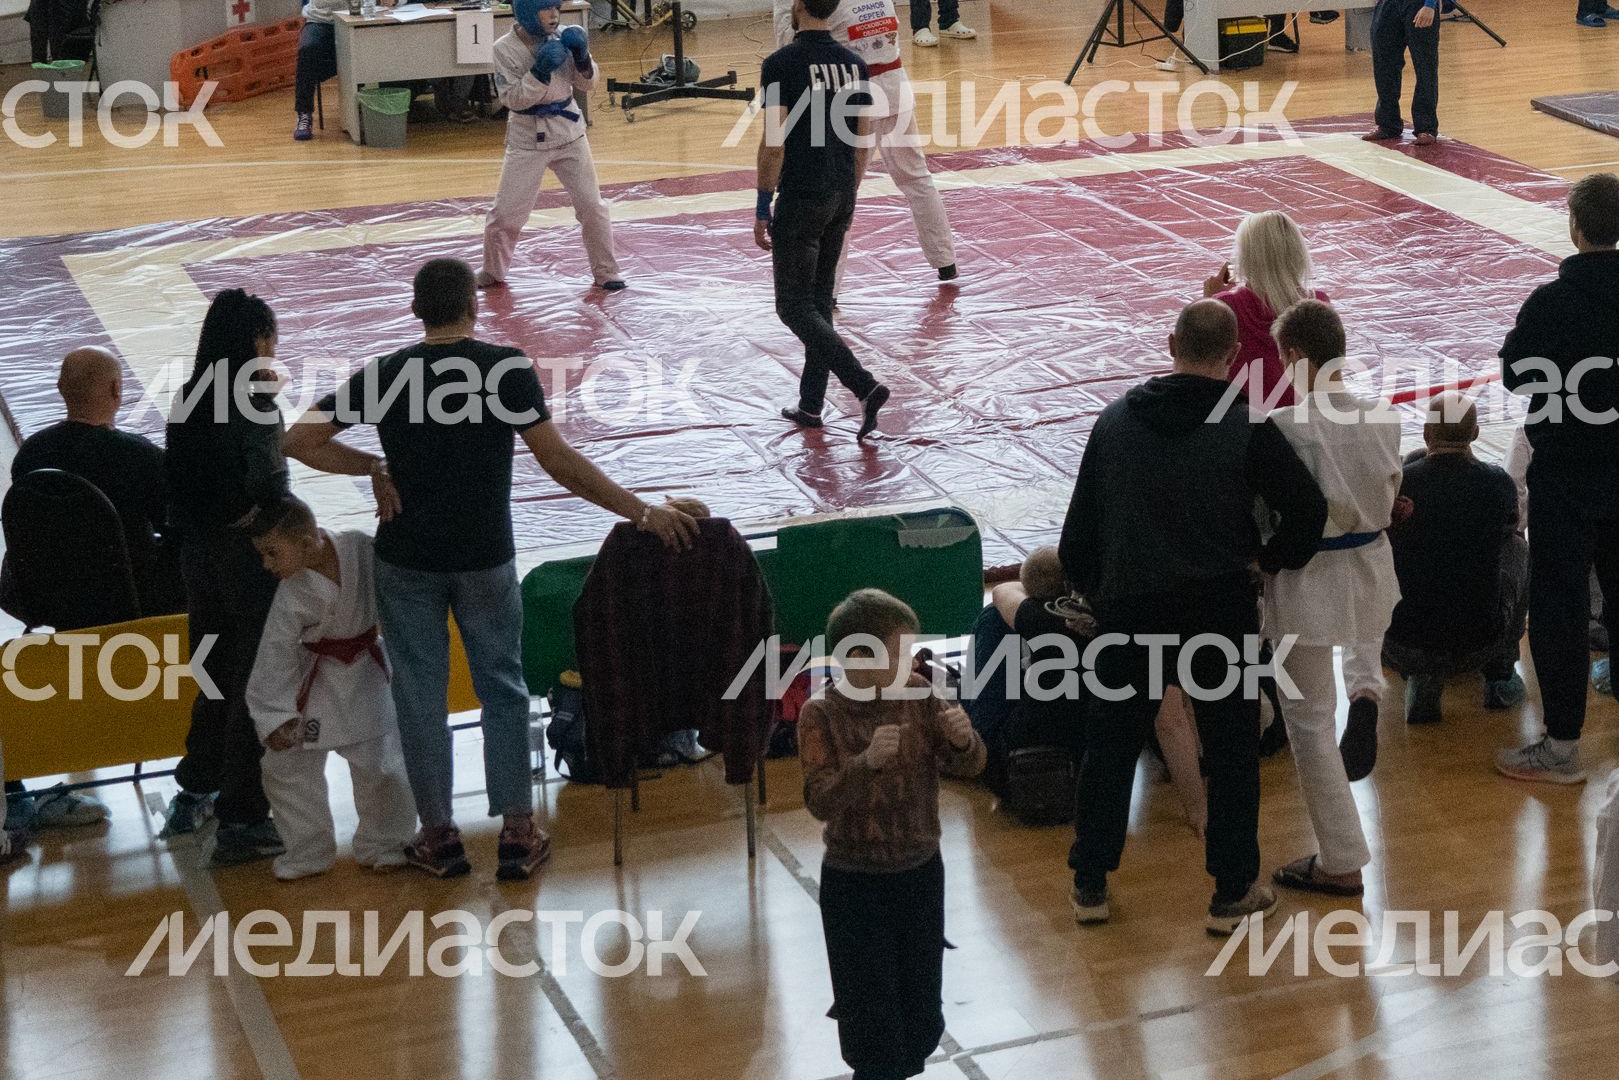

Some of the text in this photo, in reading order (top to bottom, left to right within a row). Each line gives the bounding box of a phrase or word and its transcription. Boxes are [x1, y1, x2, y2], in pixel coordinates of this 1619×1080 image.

[852, 1, 885, 14] САРАНОВ
[858, 10, 885, 22] СЕРГЕЙ
[855, 18, 892, 31] МОСКОВСКАЯ
[471, 24, 480, 45] 1
[809, 64, 860, 91] СУДЬЯ
